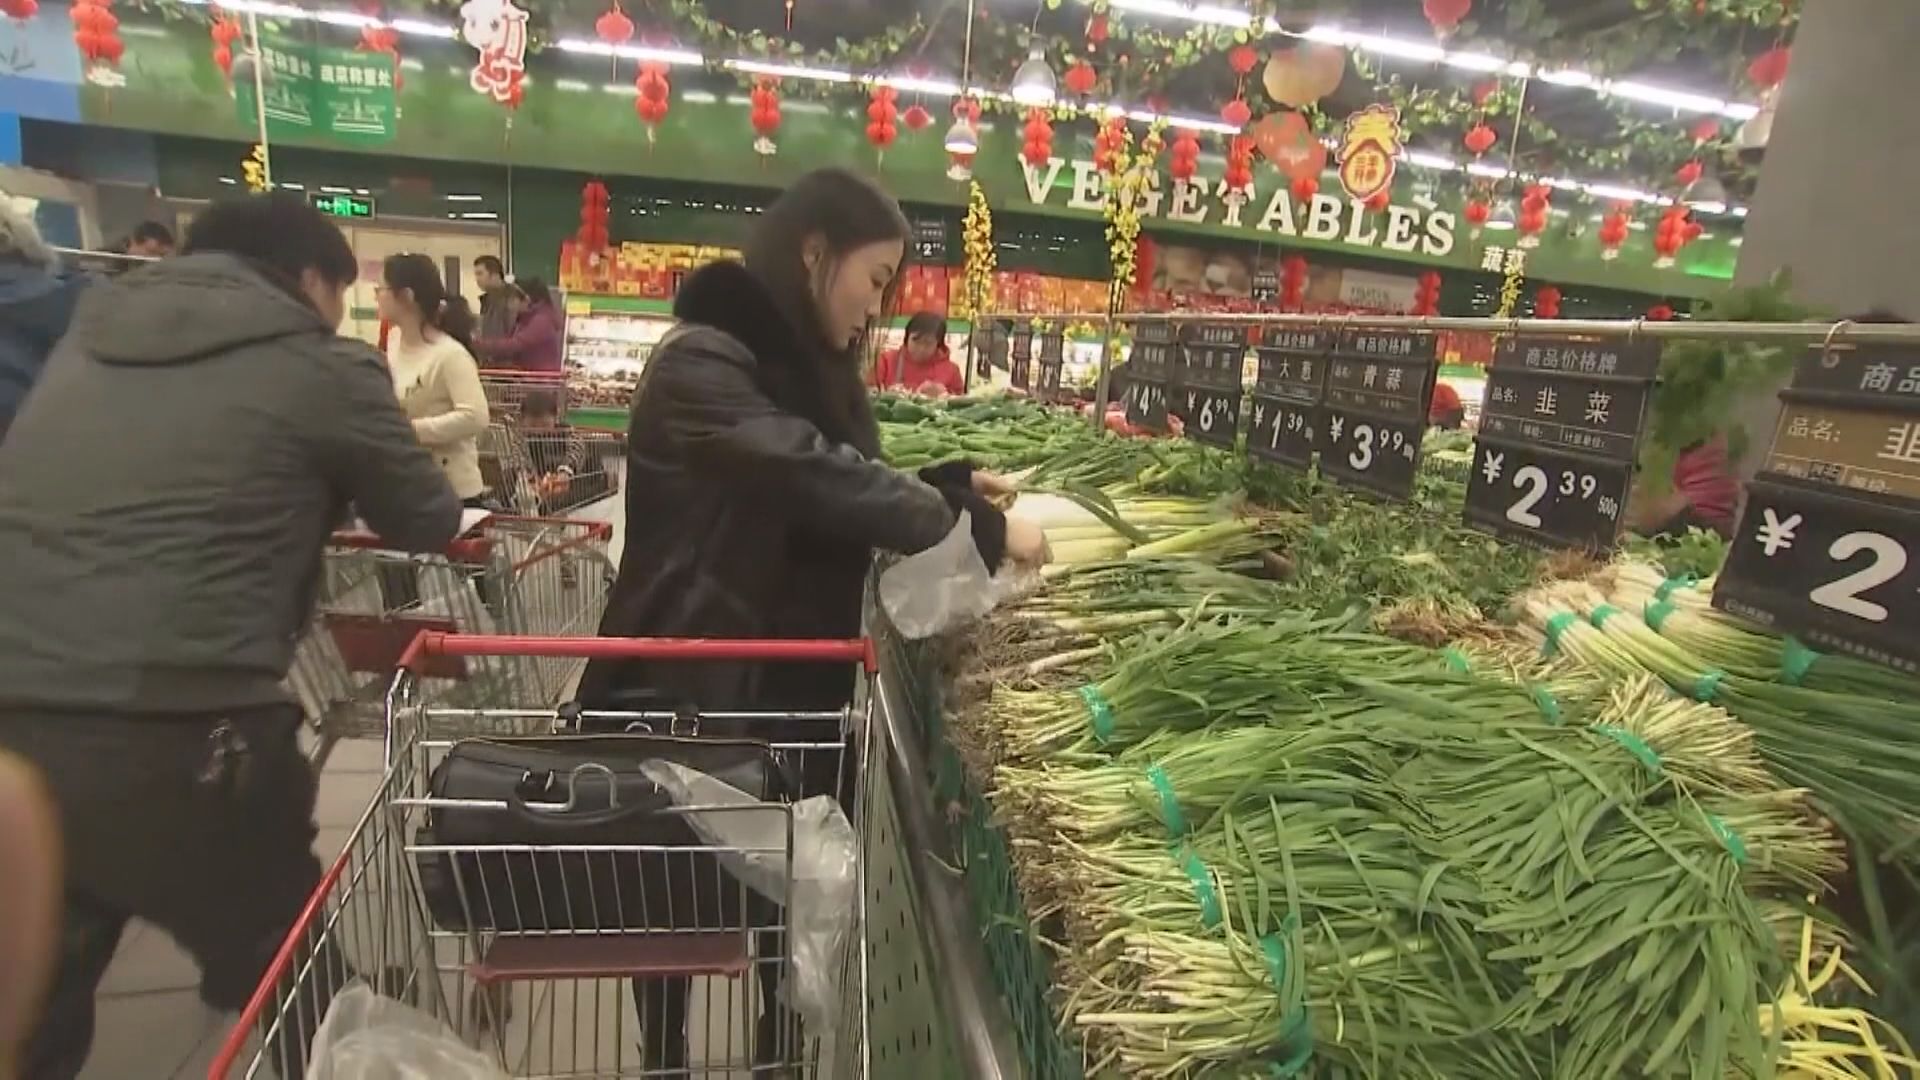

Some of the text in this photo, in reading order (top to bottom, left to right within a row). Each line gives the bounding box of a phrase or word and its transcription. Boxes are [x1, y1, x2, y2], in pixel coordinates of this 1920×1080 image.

[320, 64, 391, 88] 蔬菜称重处
[1018, 152, 1457, 258] VEGETABLES
[1356, 336, 1410, 355] 商品价格牌
[1526, 348, 1617, 375] 商品价格牌
[1859, 362, 1920, 393] 商品
[1491, 386, 1611, 424] 品名: 韭菜
[1787, 416, 1841, 444] 品名:
[1598, 496, 1618, 521] 500g
